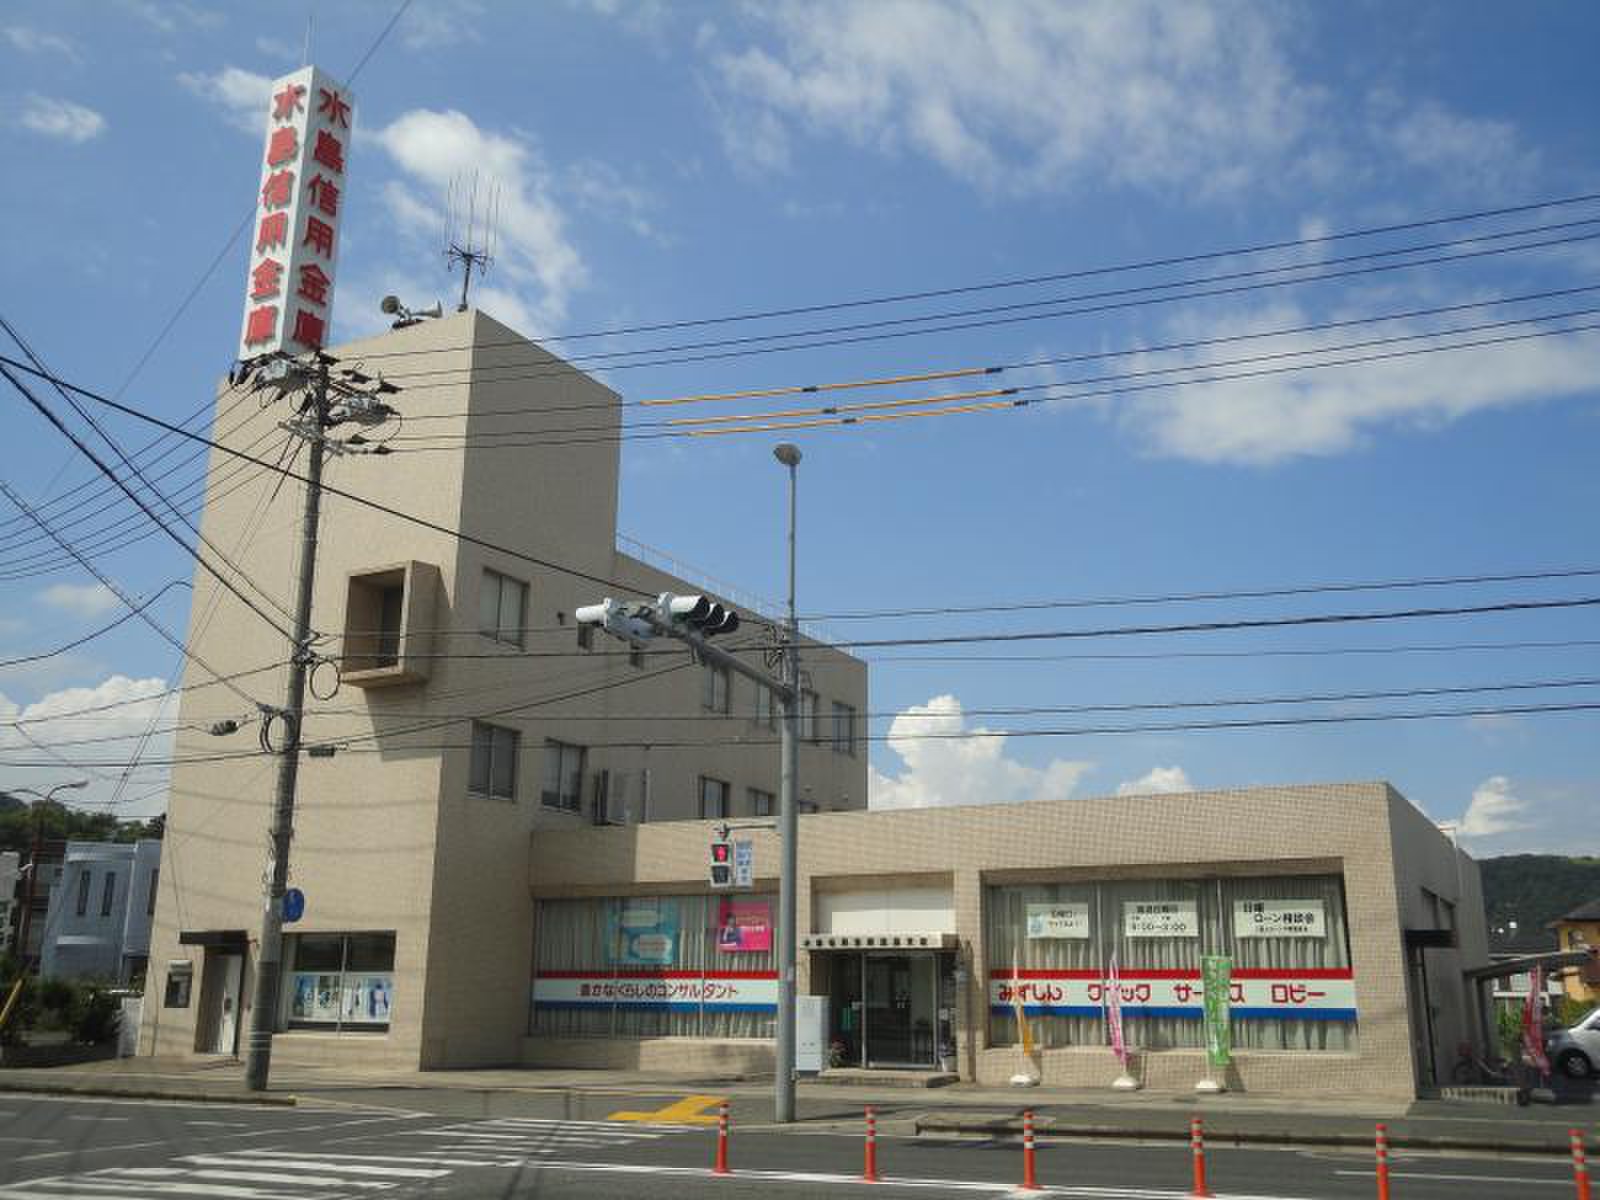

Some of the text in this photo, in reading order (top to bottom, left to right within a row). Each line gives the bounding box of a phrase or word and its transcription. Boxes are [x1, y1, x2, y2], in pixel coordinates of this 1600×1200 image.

[1173, 983, 1246, 1002] サース
[1271, 983, 1326, 1003] ロビー
